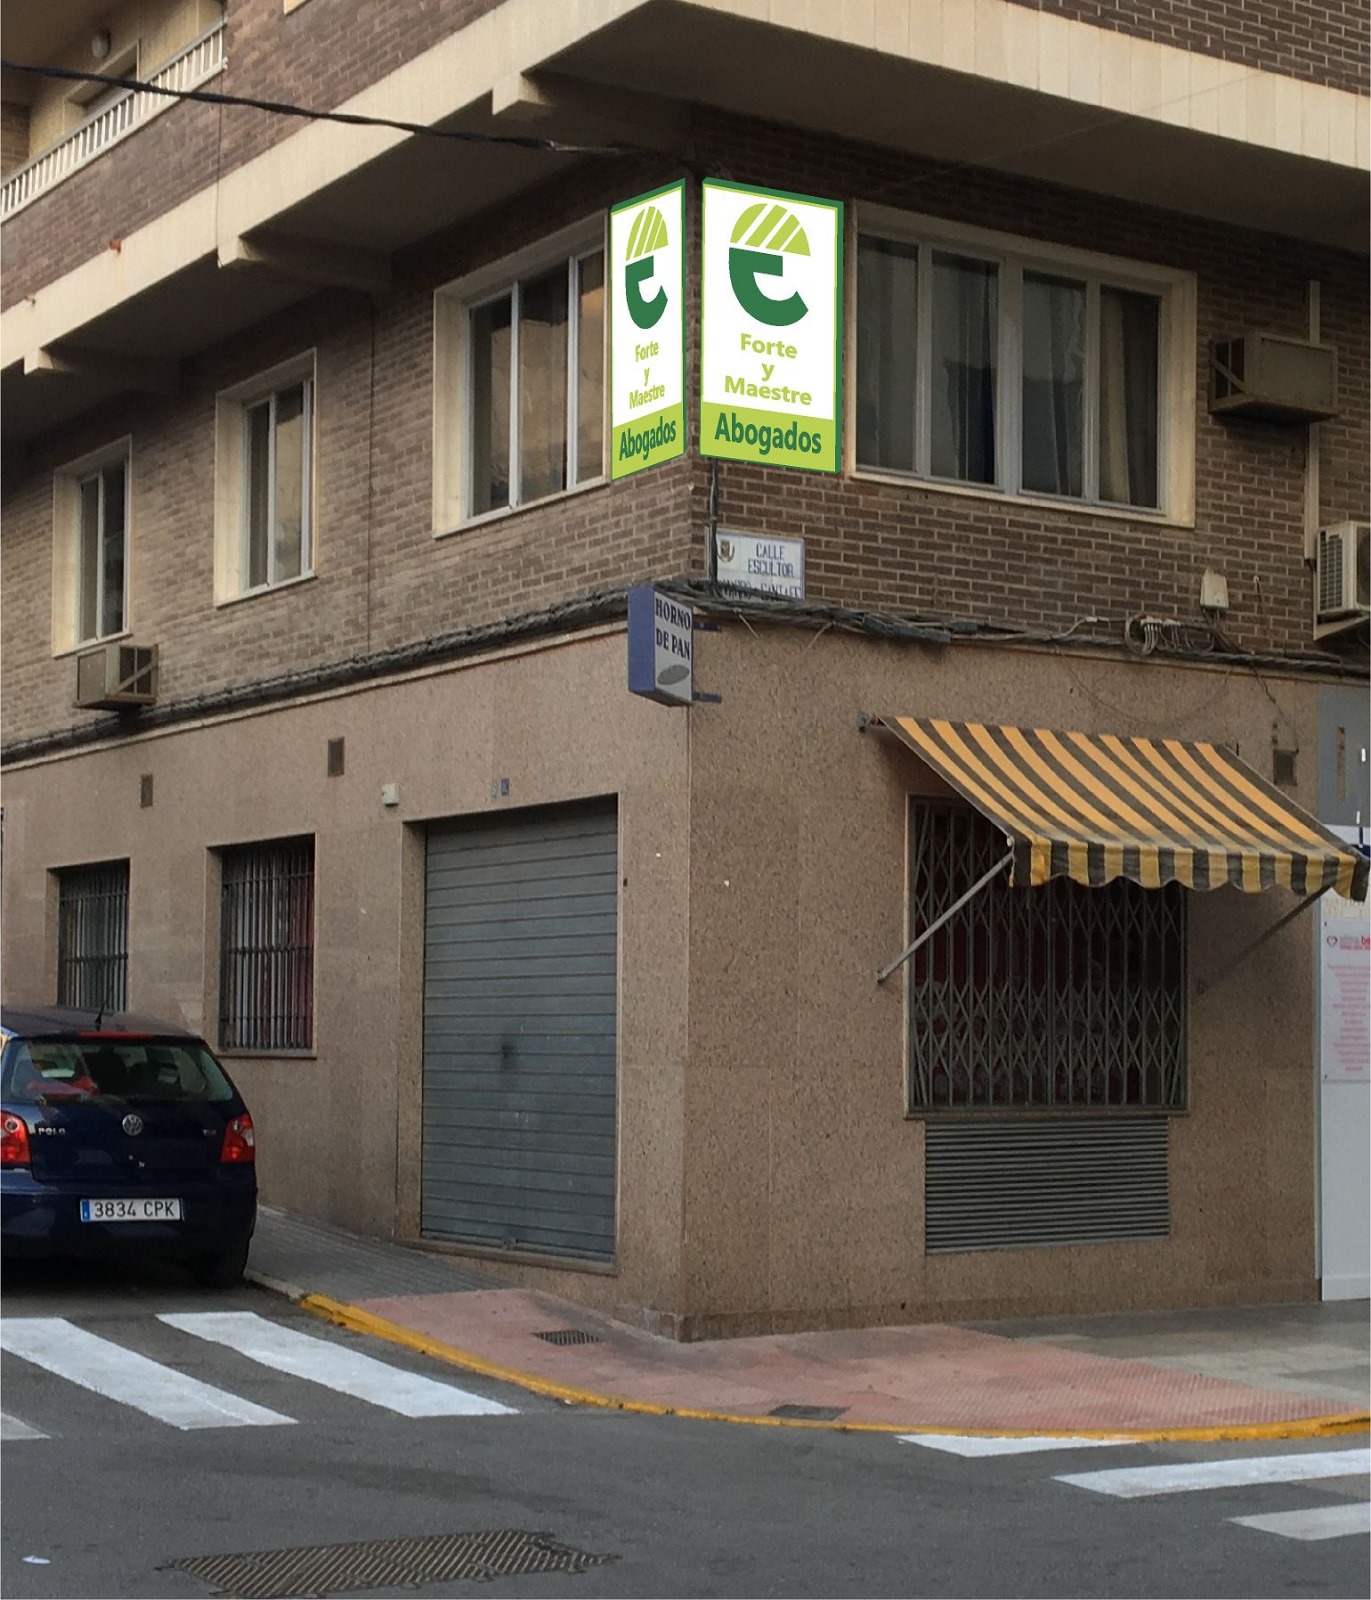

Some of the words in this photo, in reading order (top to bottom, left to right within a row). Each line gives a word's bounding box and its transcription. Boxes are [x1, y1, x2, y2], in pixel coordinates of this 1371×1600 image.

[635, 341, 659, 362] Forte
[740, 333, 798, 359] Forte
[643, 367, 650, 387] y
[761, 362, 775, 382] y
[629, 384, 665, 409] Maestre
[724, 375, 812, 406] Maestre
[619, 416, 676, 461] Abogados
[714, 412, 822, 456] Abogados
[756, 542, 785, 560] CALLE
[747, 558, 794, 578] ESCULTOR
[655, 598, 691, 630] HORNO
[656, 628, 669, 651] DE
[671, 634, 691, 661] PAN
[38, 1127, 66, 1136] POLO
[94, 1201, 137, 1218] 3834
[143, 1200, 175, 1217] CPK
